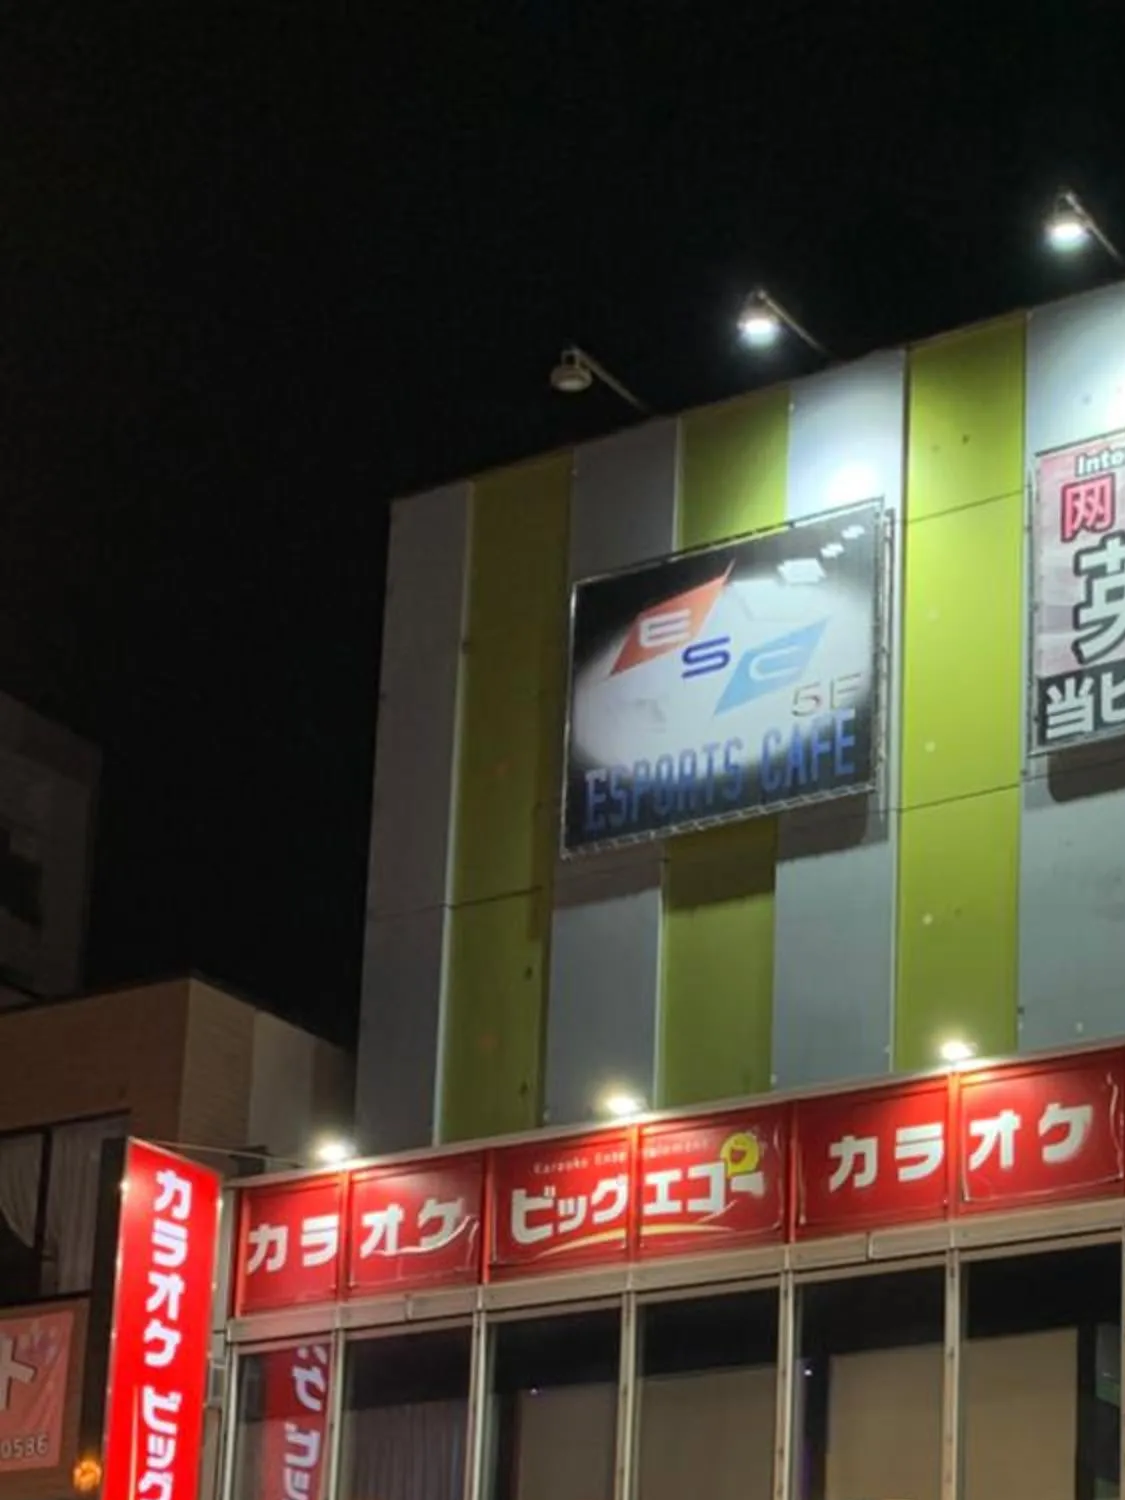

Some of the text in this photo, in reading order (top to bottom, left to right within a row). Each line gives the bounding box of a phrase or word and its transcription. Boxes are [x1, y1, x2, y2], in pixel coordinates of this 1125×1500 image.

[585, 707, 857, 834] ESPORTS CAFE
[828, 1103, 1093, 1193] カラオケ
[247, 1197, 466, 1276] カラオケ
[510, 1159, 767, 1245] ビッグエコー
[143, 1169, 193, 1368] カラオケ
